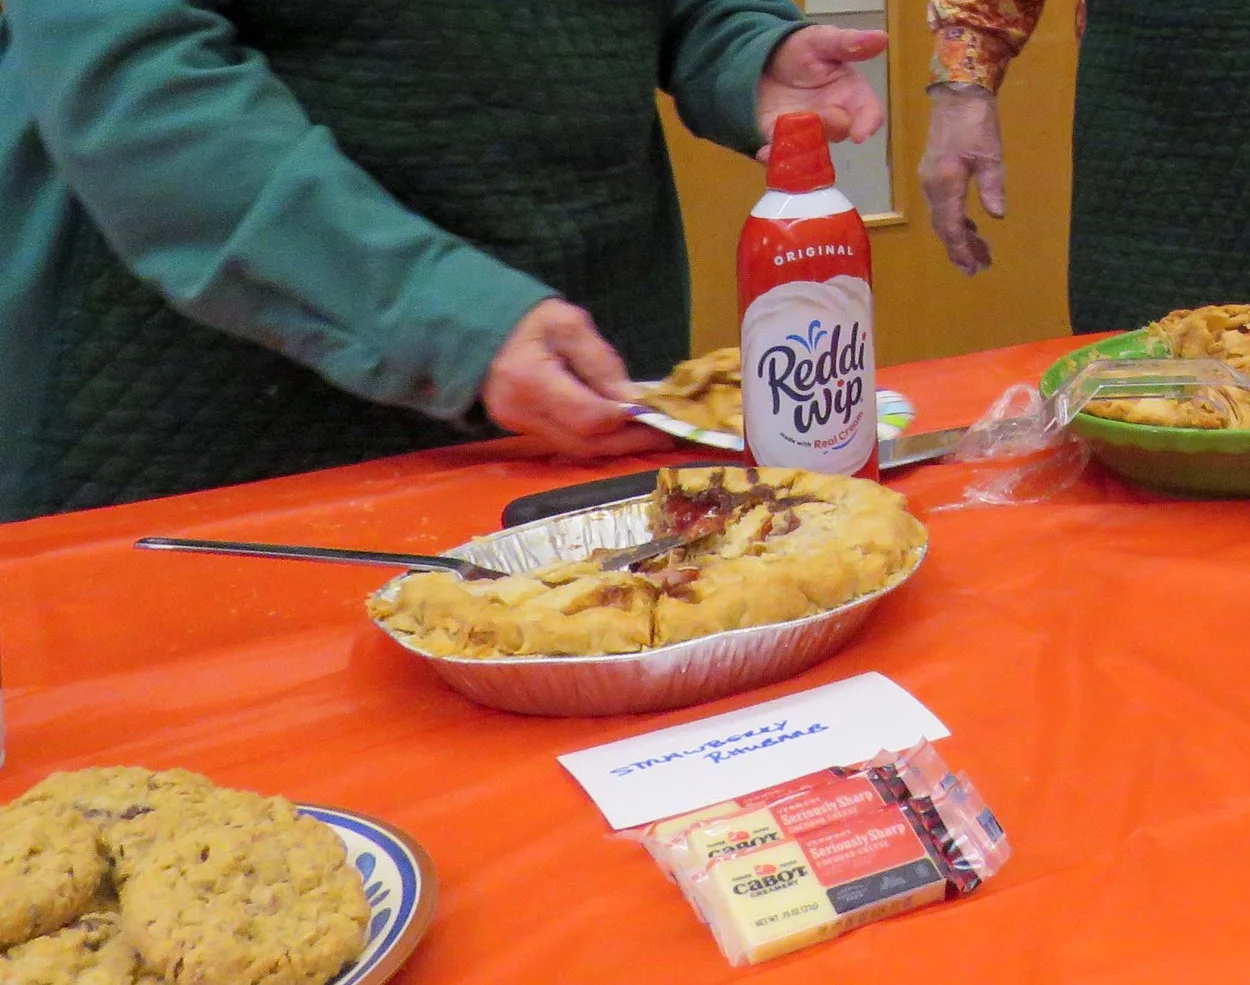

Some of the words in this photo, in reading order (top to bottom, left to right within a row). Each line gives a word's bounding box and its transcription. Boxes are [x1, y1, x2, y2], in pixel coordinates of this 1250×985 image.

[773, 244, 855, 267] ORIGINAL
[757, 320, 868, 416] Reddi
[813, 435, 838, 449] Real
[837, 410, 864, 441] Cream
[835, 789, 874, 808] Sharp
[808, 835, 868, 859] Seriously
[866, 822, 906, 841] Sharp
